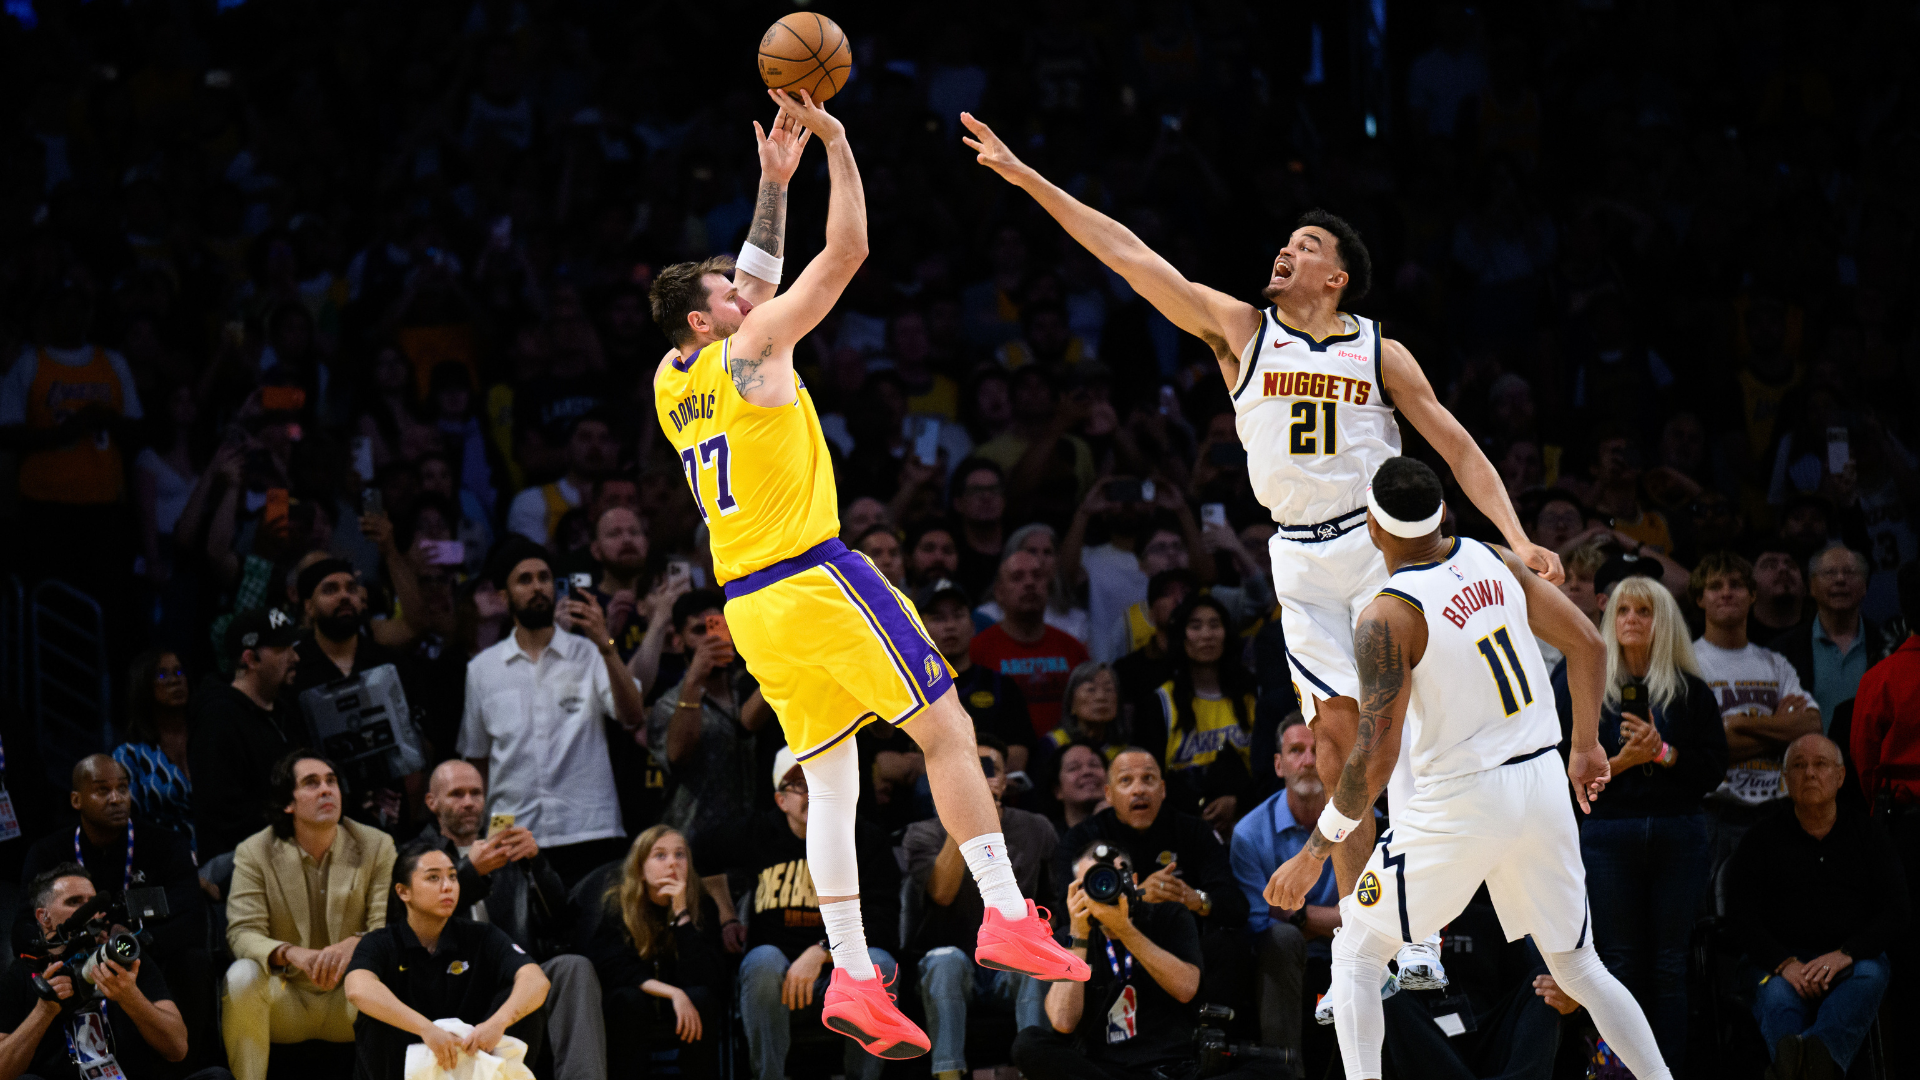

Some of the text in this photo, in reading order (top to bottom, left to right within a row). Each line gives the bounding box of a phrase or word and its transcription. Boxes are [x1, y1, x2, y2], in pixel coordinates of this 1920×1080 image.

[1338, 350, 1368, 362] ibotta
[669, 389, 715, 433] DONČIĆ
[1263, 371, 1372, 406] NUGGETS
[1289, 400, 1337, 456] 21
[680, 431, 740, 525] 77
[1442, 579, 1505, 630] BROWN
[1475, 624, 1535, 719] 11
